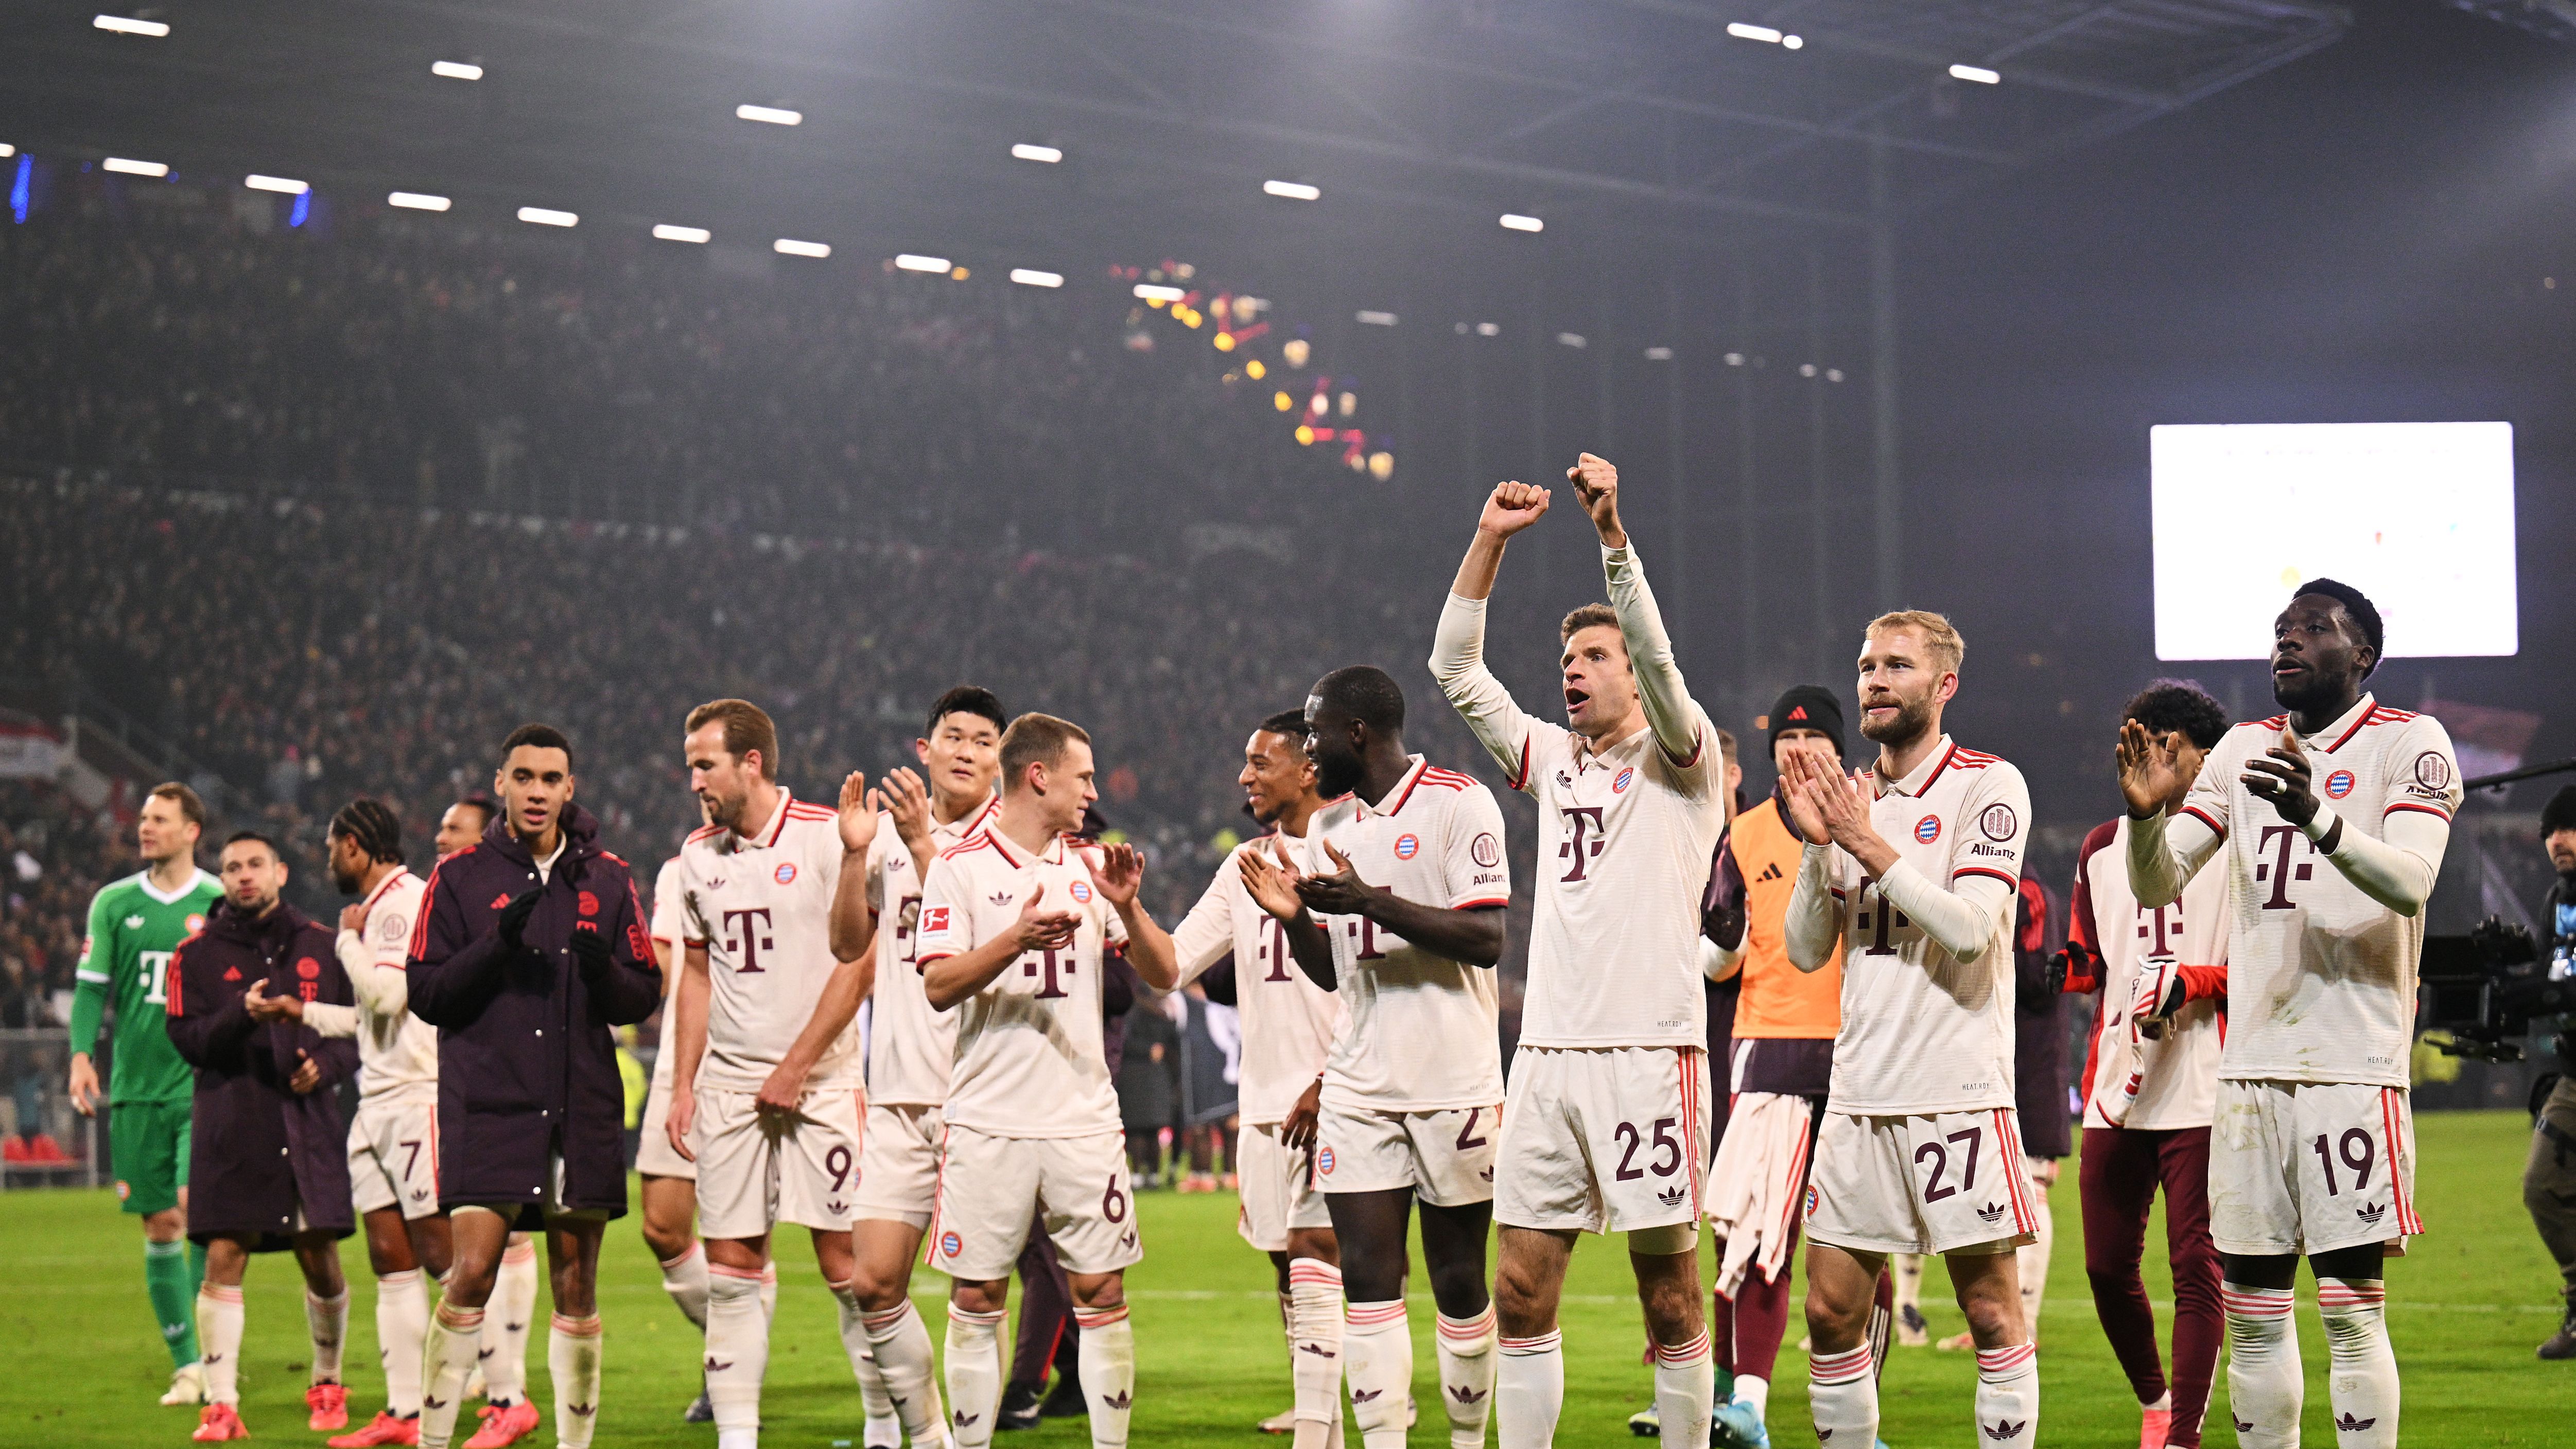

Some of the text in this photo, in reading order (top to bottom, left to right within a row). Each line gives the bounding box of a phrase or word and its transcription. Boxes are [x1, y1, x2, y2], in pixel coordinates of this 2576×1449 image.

[1559, 807, 1605, 882] T
[1971, 843, 2015, 861] Allianz
[2256, 826, 2316, 910] T
[724, 909, 773, 973] T
[1858, 876, 1908, 955] T
[139, 950, 173, 1004] T
[1260, 915, 1293, 981] T
[399, 1141, 421, 1181] 7
[826, 1145, 851, 1192] 9
[1614, 1118, 1682, 1182] 25
[1914, 1126, 1981, 1204] 27
[2314, 1128, 2374, 1196] 19
[1103, 1174, 1125, 1224] 6
